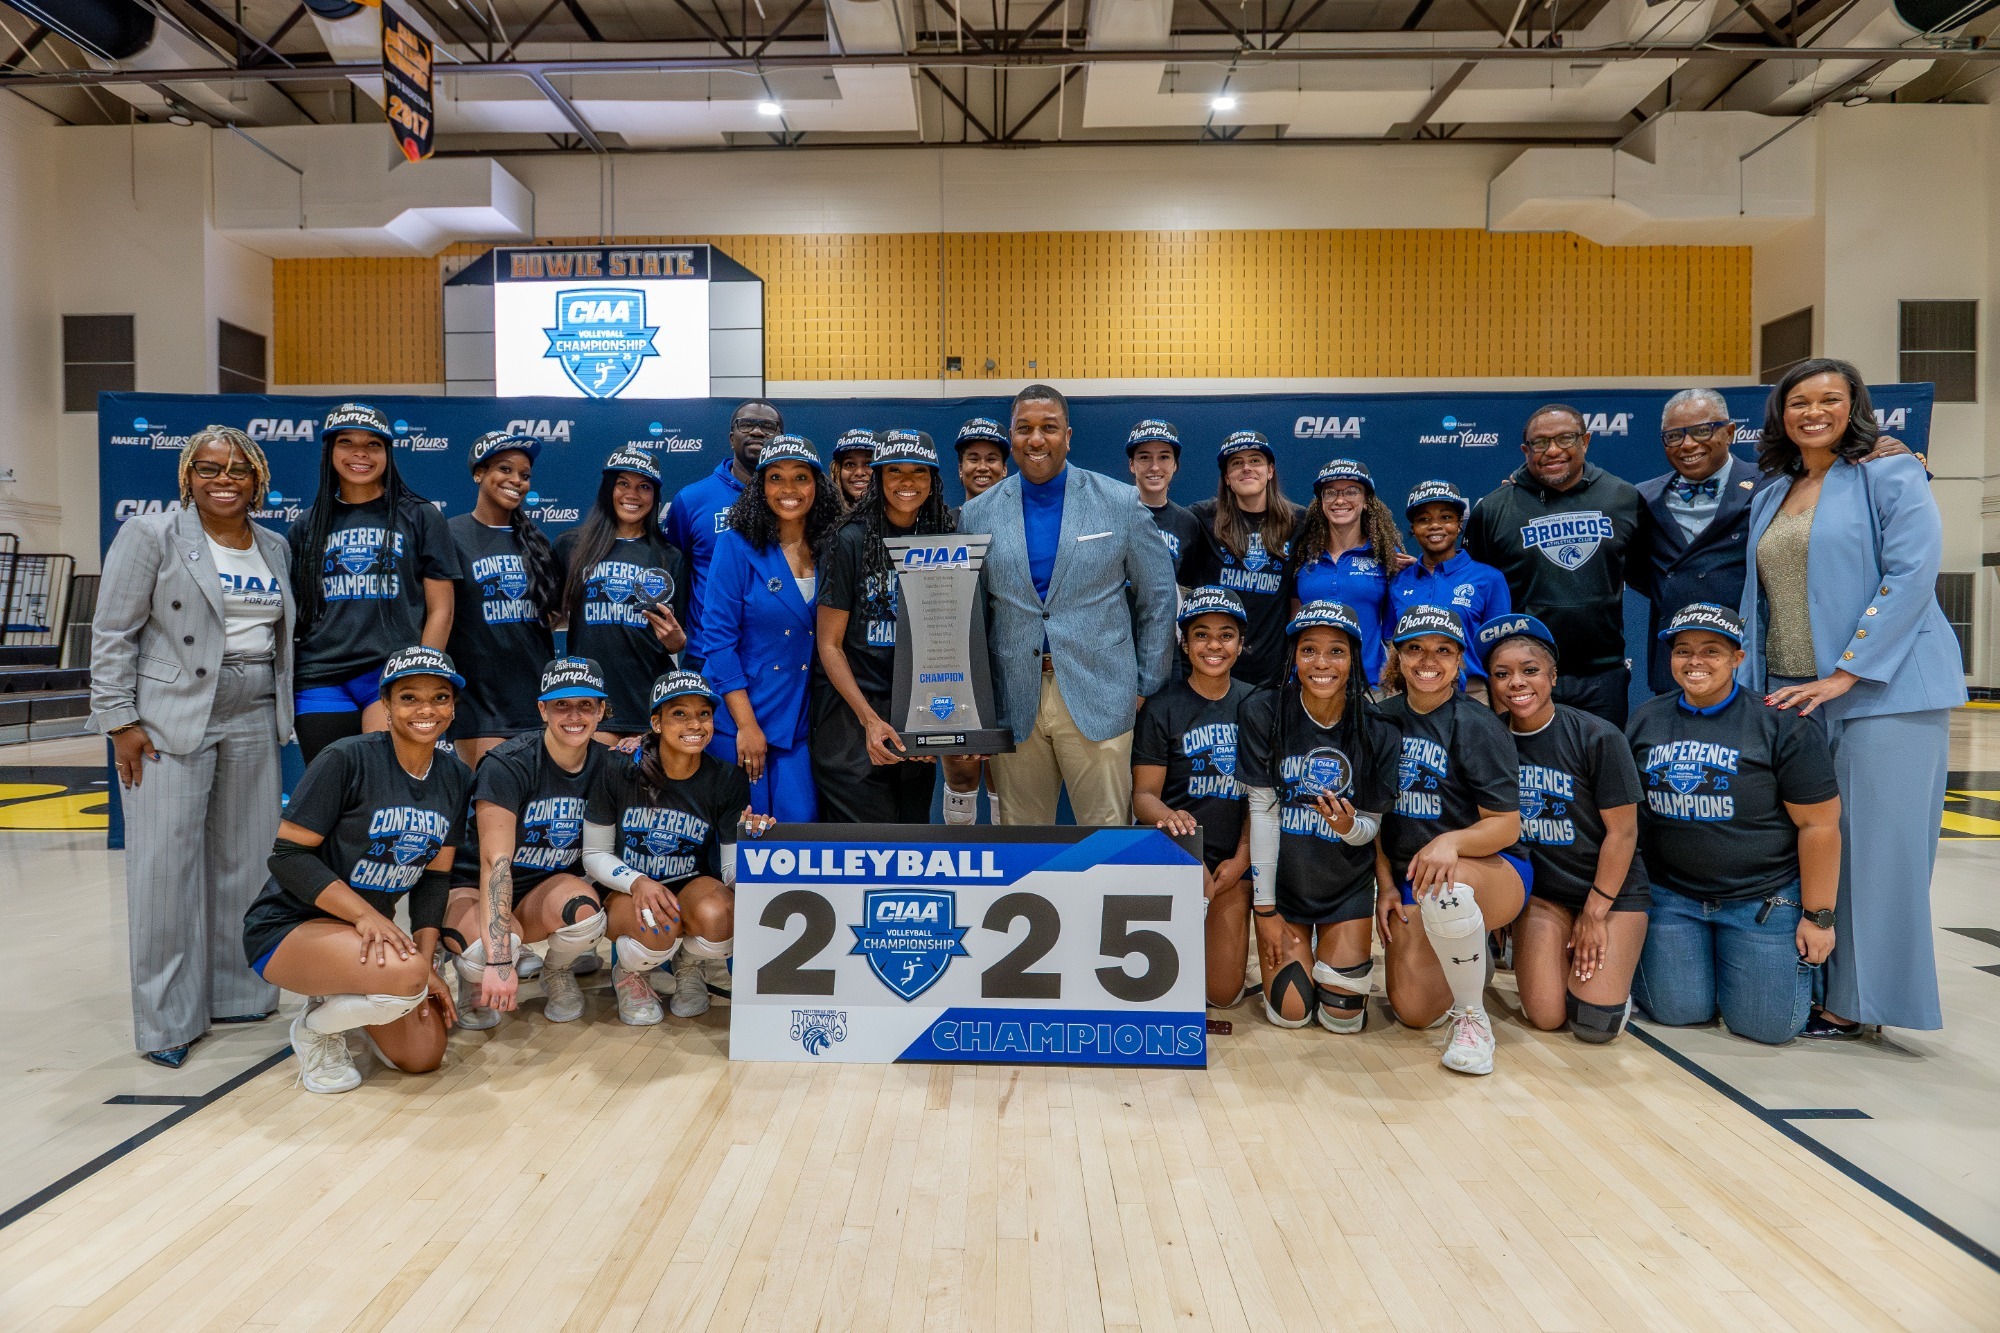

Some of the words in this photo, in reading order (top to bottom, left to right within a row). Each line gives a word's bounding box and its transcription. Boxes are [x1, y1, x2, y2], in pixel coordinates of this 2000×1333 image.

[389, 95, 429, 140] 2017
[510, 253, 602, 277] BOWIE
[609, 251, 694, 276] STATE
[567, 300, 630, 323] CIAA
[578, 330, 624, 338] VOLLEYBALL
[556, 339, 647, 352] CHAMPIONSHIP
[246, 419, 315, 442] CIAA
[506, 419, 570, 442] CIAA
[1295, 416, 1361, 439] CIAA
[1584, 412, 1628, 436] IAA
[111, 436, 139, 445] MAKE
[140, 437, 149, 445] IT
[400, 439, 409, 448] IT
[410, 434, 449, 451] YOURS
[628, 441, 654, 449] MAKE
[654, 441, 664, 449] IT
[664, 435, 703, 452] YOURS
[888, 434, 920, 442] CONFERENCE
[1419, 435, 1447, 444] MAKE
[1448, 435, 1459, 444] IT
[1459, 429, 1498, 447] YOURS
[874, 441, 937, 460] Champions
[274, 510, 284, 518] IT
[531, 511, 541, 519] IT
[541, 505, 579, 522] YOURS
[1522, 518, 1613, 547] BRONCOS
[1546, 539, 1576, 547] ATHLETICS
[472, 555, 525, 580] CONFER
[903, 546, 970, 571] CIAA
[322, 574, 400, 598] CHAMPIONS
[483, 585, 495, 596] 20
[1220, 568, 1282, 592] CHAMPIONS
[244, 597, 262, 605] FOR
[264, 598, 282, 607] LIFE
[587, 587, 597, 598] 20
[484, 600, 539, 621] CHAMPION
[1181, 594, 1242, 615] Champions
[1416, 606, 1450, 616] CONFERENCE
[1480, 618, 1530, 643] CIAA
[1670, 612, 1741, 635] Champions
[555, 662, 589, 671] CONFERENCE
[541, 671, 603, 692] Champions
[920, 672, 964, 683] CHAMPION
[1183, 723, 1239, 754] CONFERE
[1191, 758, 1205, 771] 20
[1646, 740, 1739, 771] CONFERENCE
[1424, 775, 1438, 789] 25
[1519, 765, 1573, 797] ERENCE
[1713, 775, 1729, 790] 25
[524, 797, 585, 824] CONFERE
[1552, 802, 1567, 815] 25
[1648, 790, 1733, 817] CHAMPIONS
[369, 806, 449, 843] CONFERENCE
[622, 807, 709, 843] CONFERENCE
[1520, 819, 1575, 842] MPIONS
[403, 834, 424, 842] CIAA
[525, 831, 540, 843] 20
[625, 834, 638, 847] 20
[652, 831, 673, 840] CIAA
[367, 842, 386, 856] 20
[513, 847, 582, 868] CHAMPION
[623, 846, 696, 876] CHAMPIONS
[743, 849, 1003, 878] VOLLEYBALL
[350, 860, 426, 889] CHAMPION
[876, 901, 938, 923] CIAA
[887, 929, 932, 937] VOLLEYBALL
[864, 938, 955, 950] CHAMPIONSHIP
[790, 1010, 848, 1042] BRONCOS
[931, 1020, 1204, 1056] CHAMPIONS
